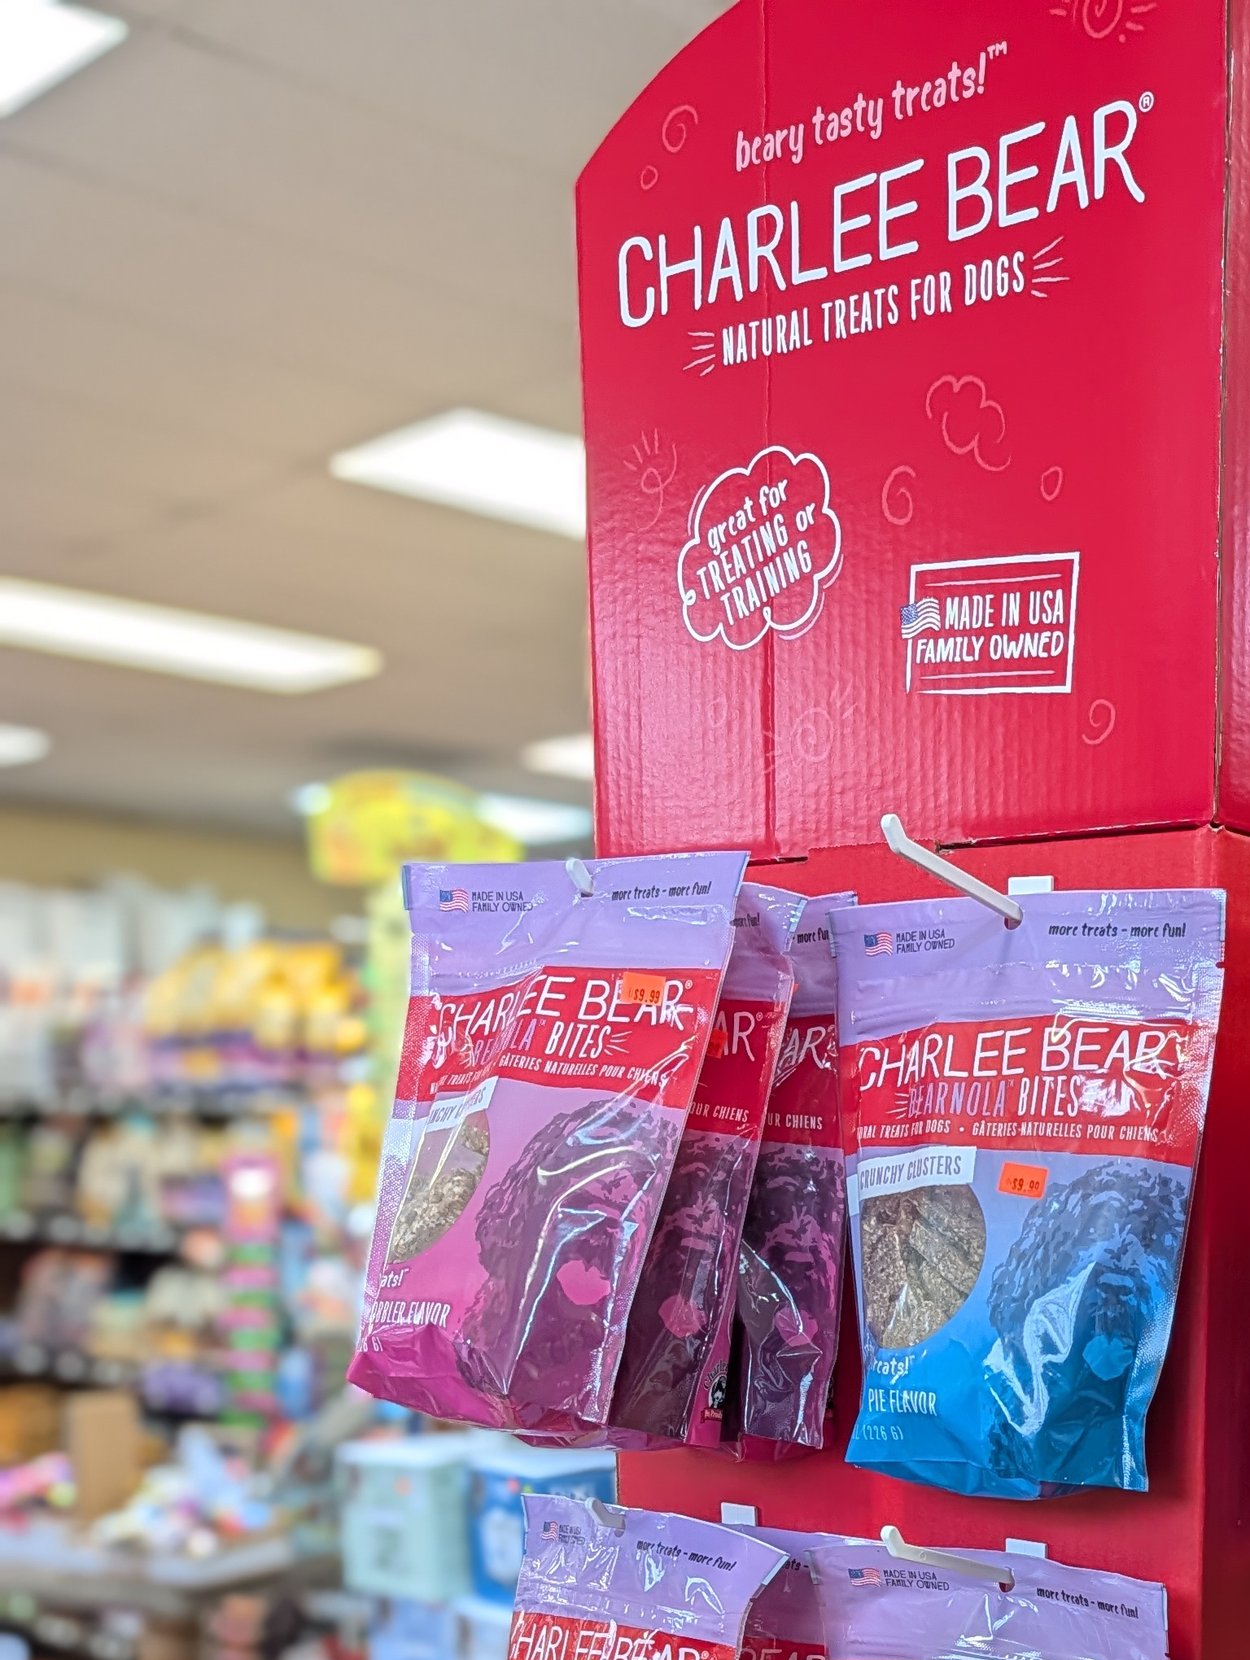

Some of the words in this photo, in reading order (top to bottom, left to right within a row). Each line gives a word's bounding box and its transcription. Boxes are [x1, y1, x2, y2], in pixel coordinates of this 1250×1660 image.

[735, 122, 804, 172] beary
[812, 93, 884, 147] tasty
[617, 158, 925, 327] CHARLEE
[721, 310, 813, 367] NATURAL
[821, 284, 899, 343] TREATS
[910, 270, 952, 320] FOR
[964, 251, 1026, 307] DOGS
[707, 501, 753, 556] great
[758, 478, 788, 517] for
[696, 514, 788, 599] TREATING
[795, 502, 816, 533] or
[720, 540, 812, 625] TRAINING
[944, 596, 994, 630] MADE
[1002, 592, 1020, 627] IN
[1028, 589, 1064, 624] USA
[916, 636, 985, 664] FAMILY
[989, 631, 1064, 660] OWNED
[895, 931, 916, 942] MADE
[919, 930, 927, 940] IN
[928, 928, 945, 939] USA
[896, 941, 923, 954] FAMILY
[925, 937, 955, 951] OWNED
[1048, 924, 1079, 937] more
[1081, 922, 1117, 938] treats
[1130, 924, 1159, 937] more
[1162, 922, 1185, 938] fun!
[883, 1569, 906, 1579] MADE
[908, 1571, 916, 1580] IN
[918, 1572, 937, 1581] USA
